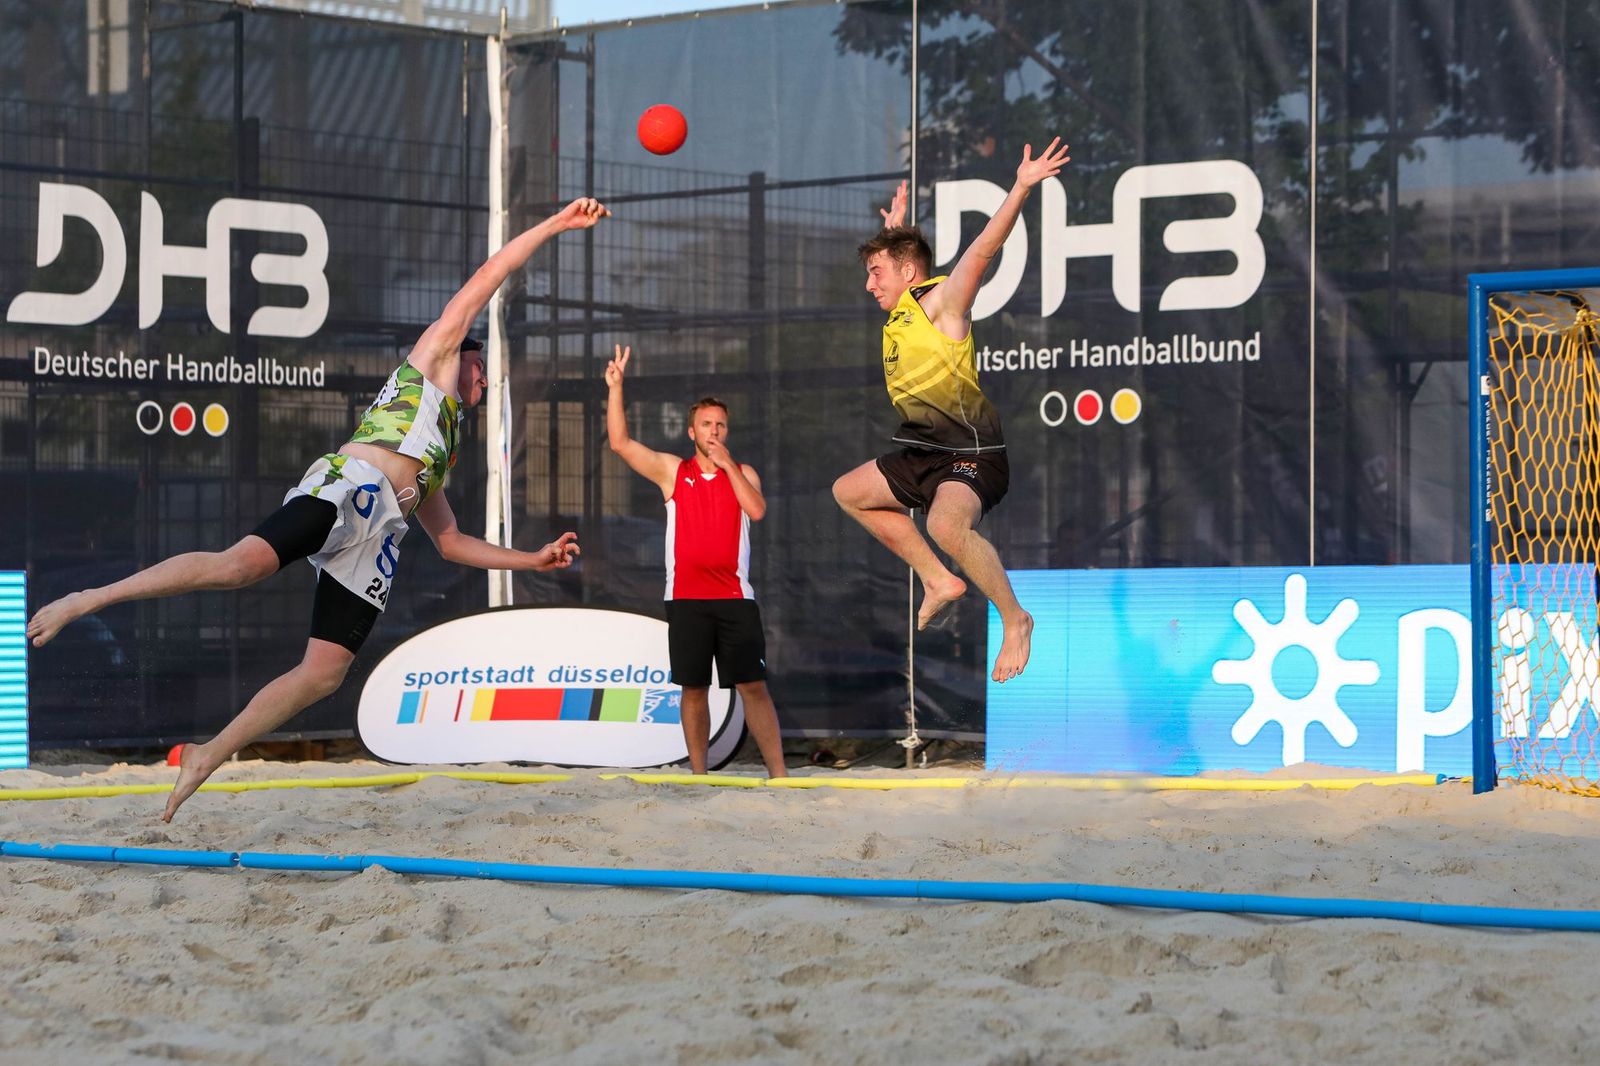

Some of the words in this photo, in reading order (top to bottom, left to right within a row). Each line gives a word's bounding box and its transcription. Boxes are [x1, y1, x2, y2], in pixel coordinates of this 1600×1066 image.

[6, 182, 330, 338] DHB
[934, 159, 1266, 321] DHB
[34, 346, 160, 380] Deutscher
[167, 353, 325, 388] Handballbund
[1070, 331, 1261, 368] Handballbund
[404, 666, 534, 690] sportstadt
